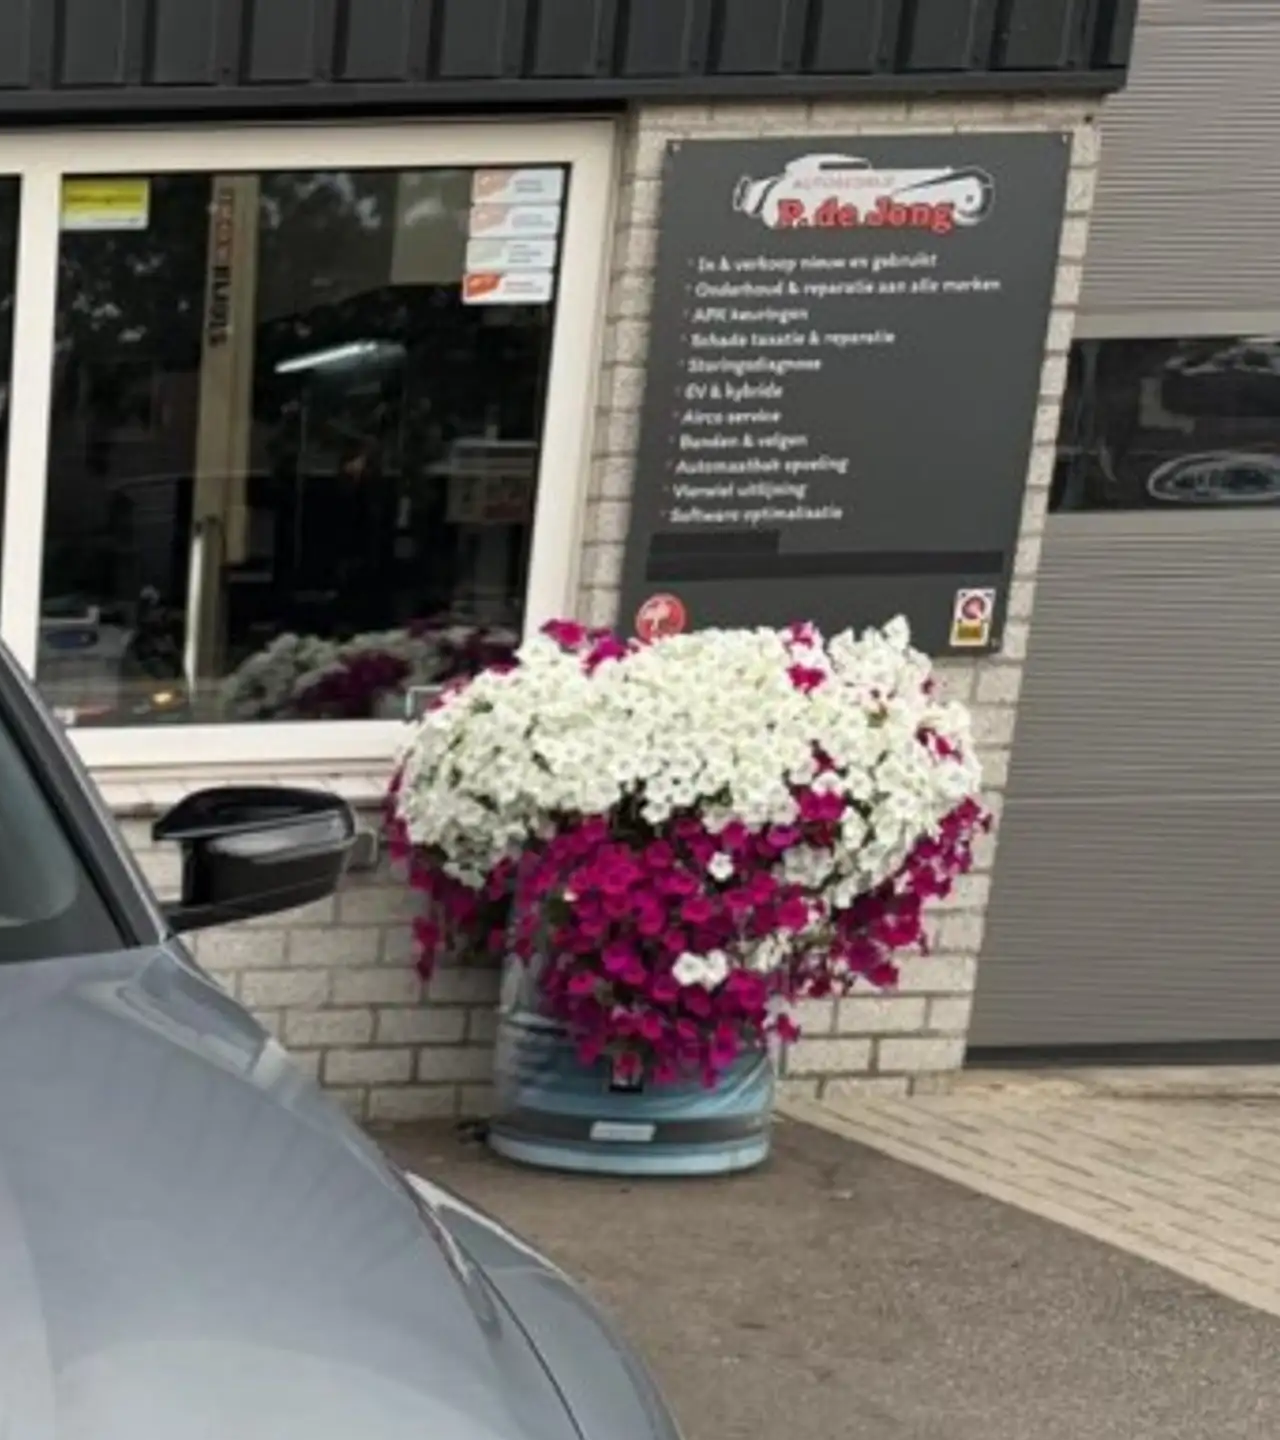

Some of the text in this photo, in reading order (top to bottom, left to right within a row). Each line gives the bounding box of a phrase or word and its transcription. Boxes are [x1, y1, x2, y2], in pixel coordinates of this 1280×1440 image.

[776, 195, 956, 237] P. de Jong
